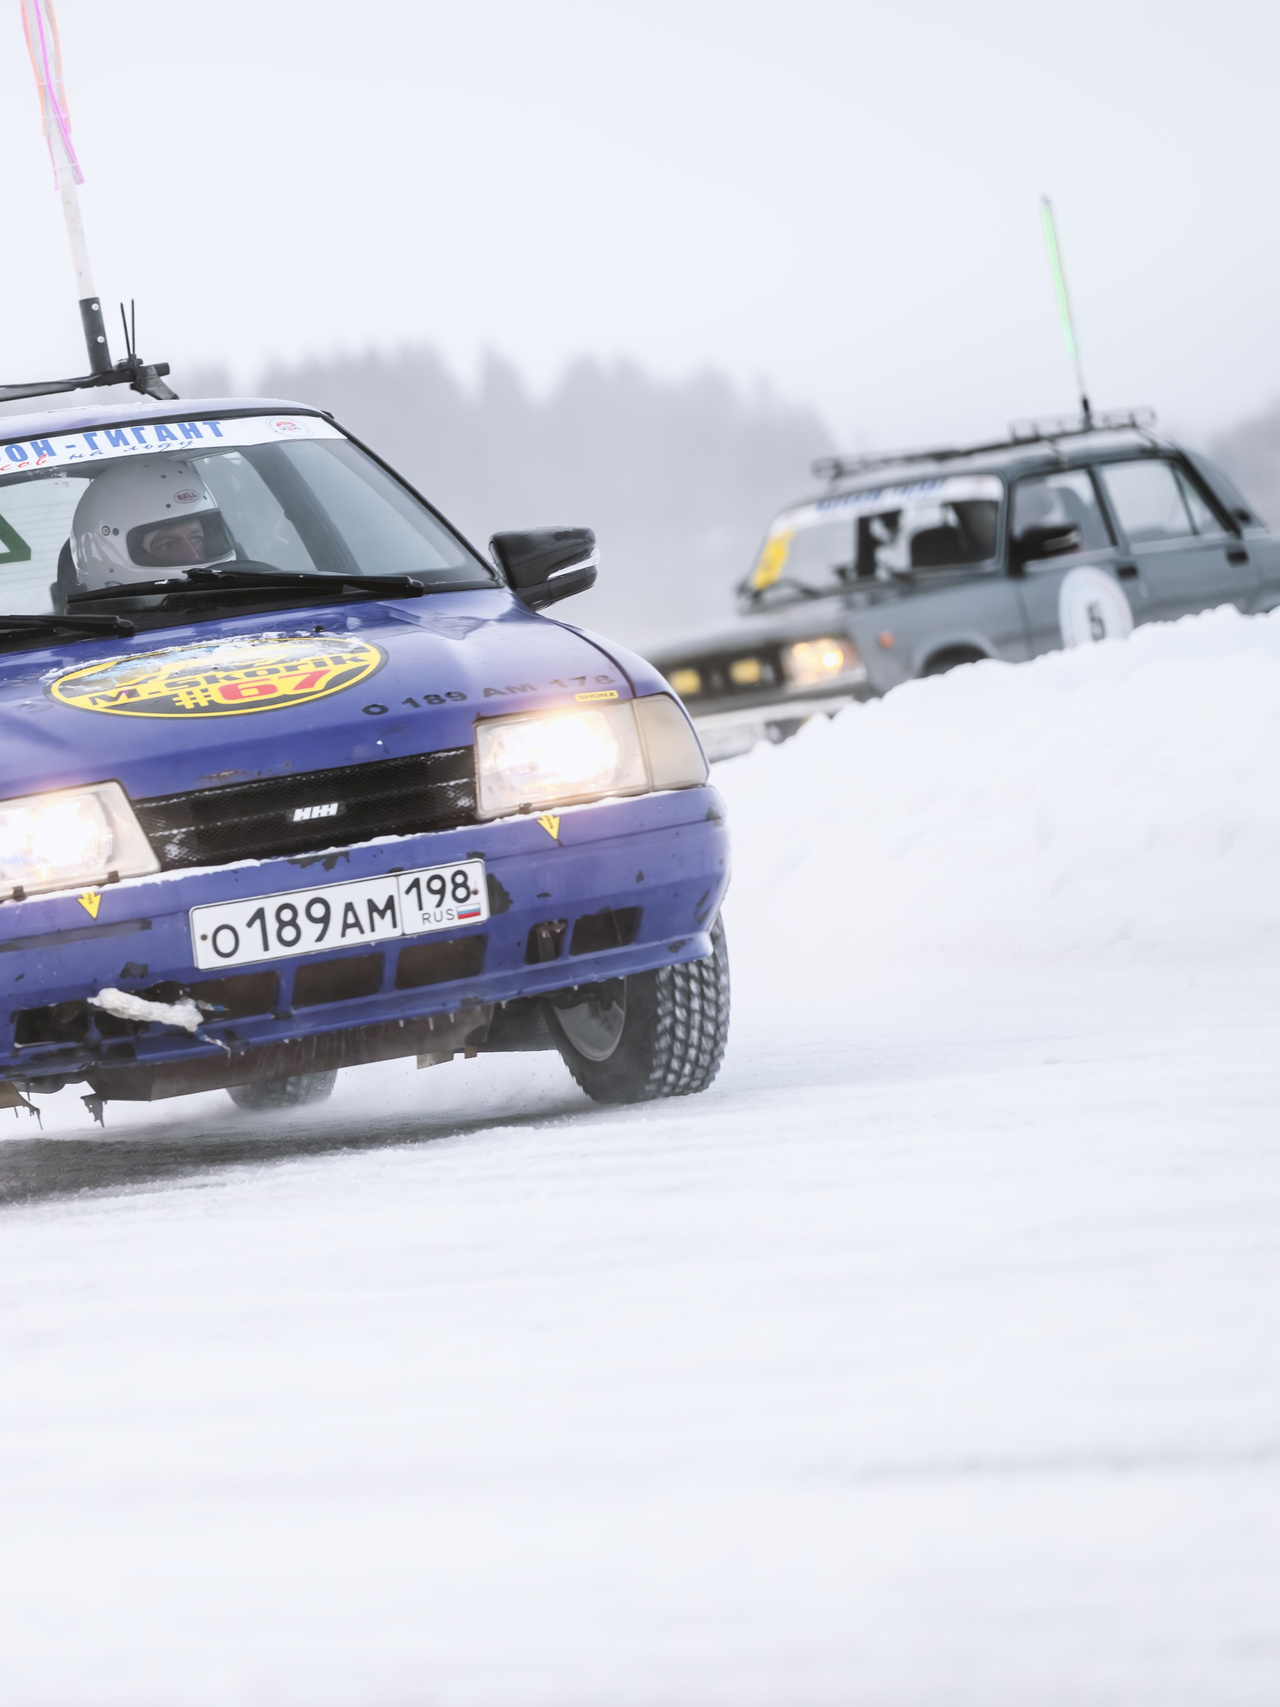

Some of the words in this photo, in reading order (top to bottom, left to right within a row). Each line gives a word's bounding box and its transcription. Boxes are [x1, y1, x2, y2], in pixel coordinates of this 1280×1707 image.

[401, 691, 468, 709] 189
[404, 869, 471, 912] 198
[422, 907, 456, 925] RUS
